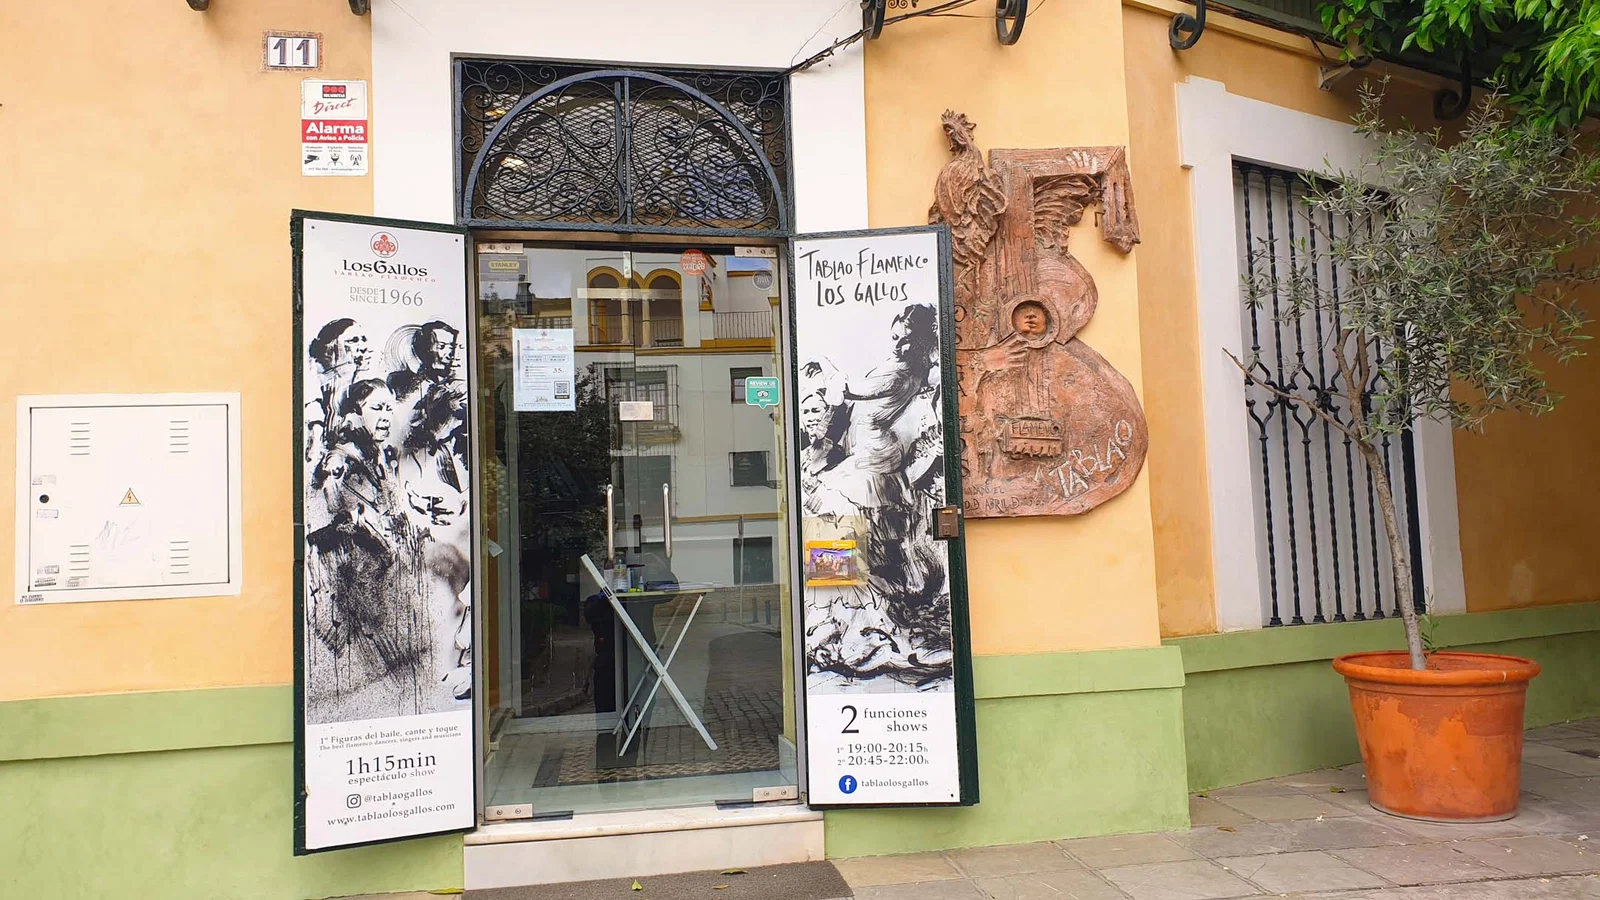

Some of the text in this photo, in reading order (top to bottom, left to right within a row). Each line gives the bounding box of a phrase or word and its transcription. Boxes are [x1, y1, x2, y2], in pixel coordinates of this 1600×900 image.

[273, 39, 310, 65] 11
[313, 98, 357, 115] Direct
[306, 121, 364, 134] Alarma
[800, 247, 929, 280] TABLAO FLAMENCO
[350, 286, 423, 307] DESDE 1966
[350, 294, 378, 304] SINCE
[817, 281, 908, 306] LOS GALLOS
[1049, 420, 1133, 498] TABLAO
[841, 705, 927, 734] 2 funciones
[886, 721, 928, 732] shows
[331, 735, 362, 745] Figuras
[365, 732, 378, 740] del
[380, 730, 402, 738] baile,
[405, 728, 426, 736] cante
[436, 725, 459, 734] toque
[346, 741, 373, 749] flamenco
[400, 736, 420, 744] singers
[346, 752, 437, 775] 1h15min
[348, 767, 436, 786] espectáculo show
[861, 779, 929, 789] tablaolosgallos
[364, 788, 433, 802] @tablaogallos
[327, 803, 455, 826] www.tablaolosgallos.com
